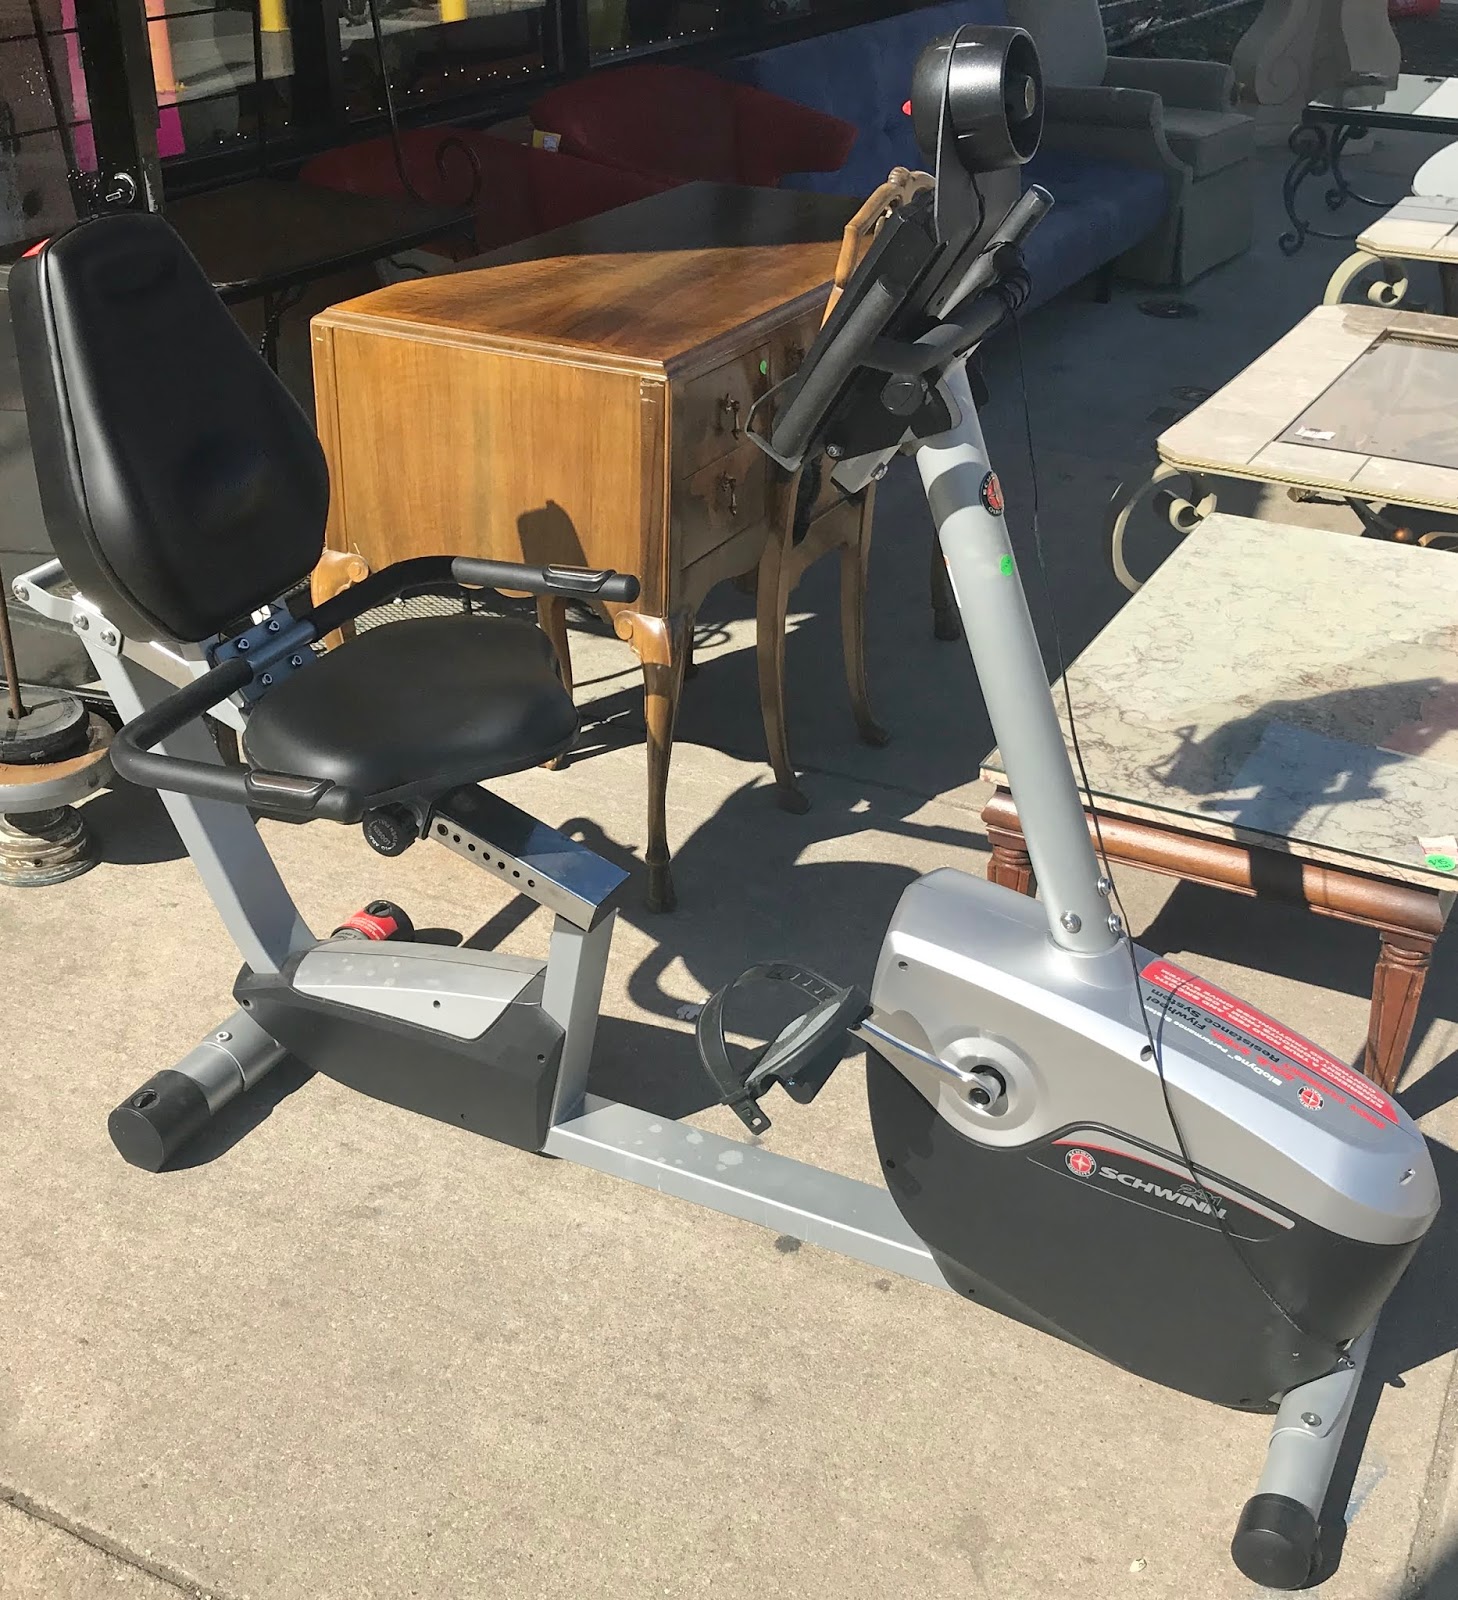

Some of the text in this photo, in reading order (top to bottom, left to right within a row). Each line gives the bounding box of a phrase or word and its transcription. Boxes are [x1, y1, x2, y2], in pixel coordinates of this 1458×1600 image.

[1160, 967, 1201, 991] SYSTEM
[1146, 994, 1206, 1030] Flywheel
[1151, 987, 1201, 1018] System
[1201, 998, 1224, 1014] AND
[1202, 989, 1234, 1009] DRIVE
[1221, 1004, 1229, 1012] A
[1225, 1011, 1250, 1028] FEEL
[1230, 1009, 1260, 1029] FROM
[1173, 1020, 1228, 1053] Performance
[1203, 1016, 1279, 1063] Resistance
[1251, 1026, 1281, 1045] ROAD
[1261, 1026, 1319, 1063] WORKOUTS
[1282, 1044, 1309, 1062] TRUE
[1309, 1050, 1376, 1093] CONTROLLED
[1320, 1061, 1384, 1104] CONSISTENT
[1319, 1066, 1383, 1109] EXPERIENCE
[1098, 1166, 1227, 1220] SCHWINN
